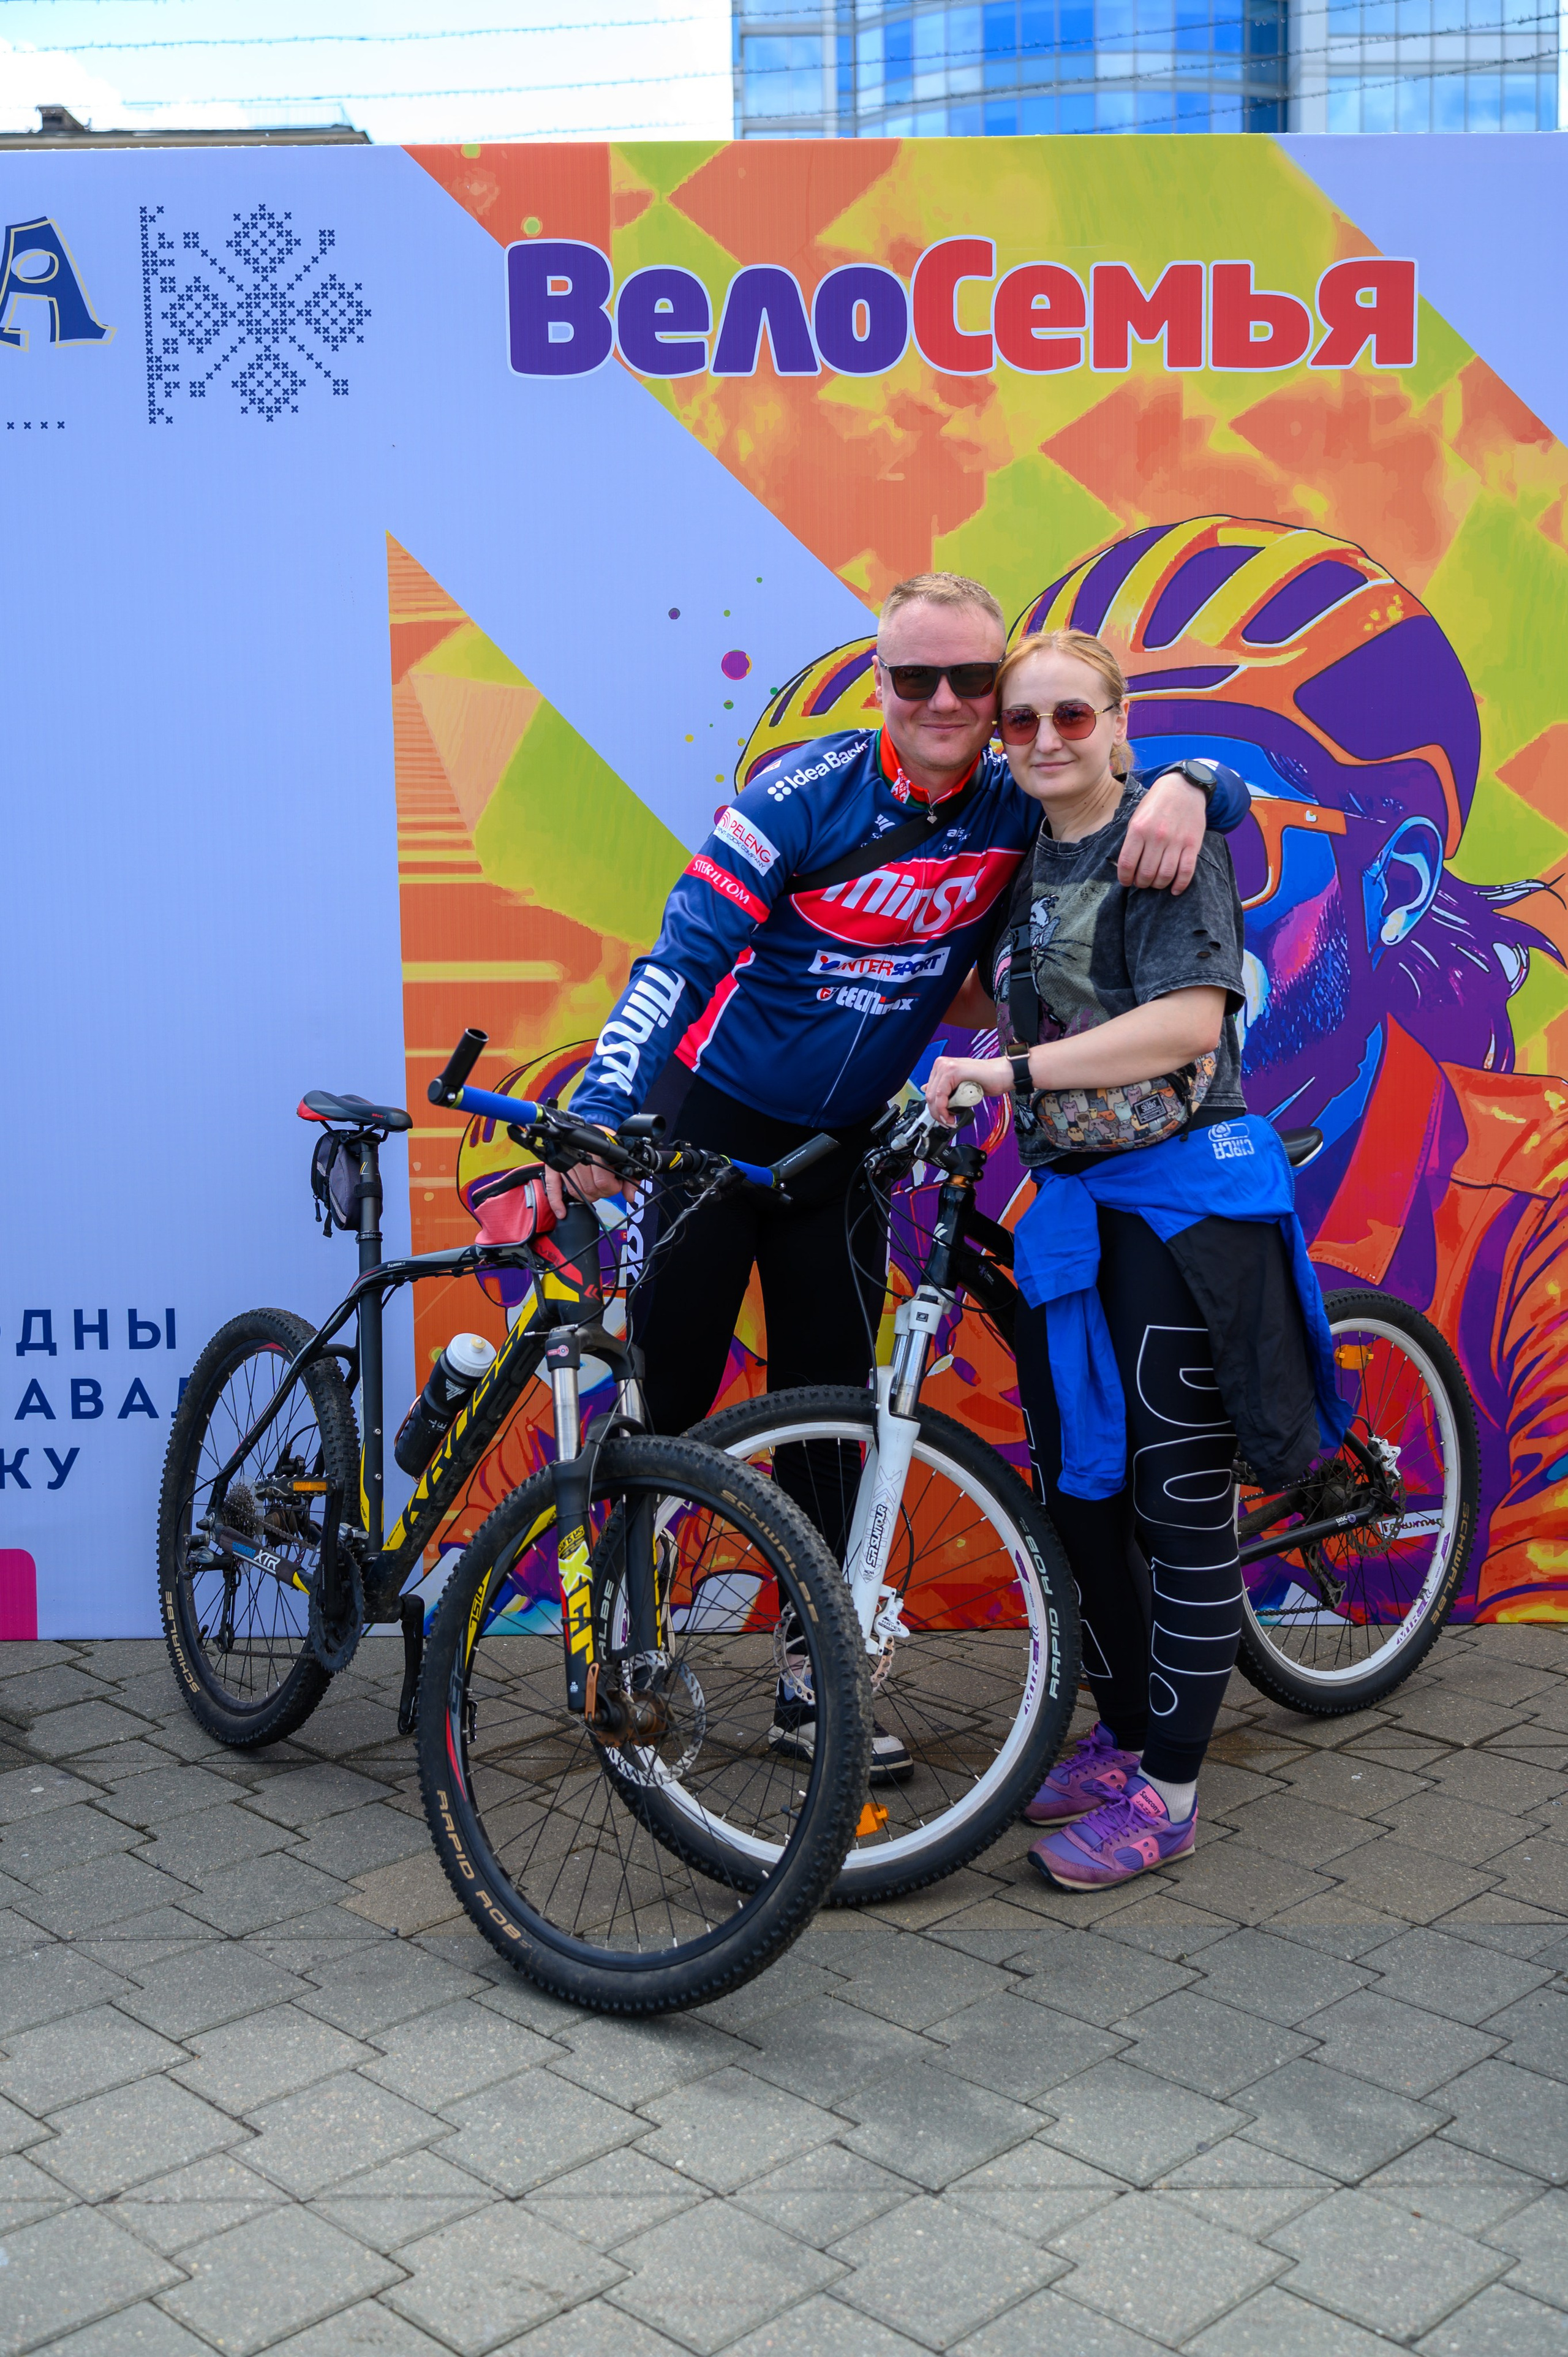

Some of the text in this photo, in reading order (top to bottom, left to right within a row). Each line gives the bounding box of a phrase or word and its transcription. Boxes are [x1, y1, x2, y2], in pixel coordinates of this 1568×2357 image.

[506, 236, 1419, 378] ВелоСемья
[731, 820, 772, 864] PELENG
[693, 859, 750, 905] STERILTOM
[837, 953, 943, 976] INTERSPORT
[1212, 1138, 1255, 1160] CIRCA
[0, 1308, 176, 1356] ДНЫ
[254, 1549, 281, 1572] XTR
[1025, 1534, 1052, 1596] ROB
[1431, 1502, 1471, 1626] SCHWALBE
[165, 1591, 200, 1694] SCHWALBE
[1049, 1607, 1061, 1700] RAPID
[1136, 1800, 1152, 1815] JAZZ
[1139, 1790, 1161, 1814] Saucony
[437, 1789, 521, 1939] RAPID ROB
